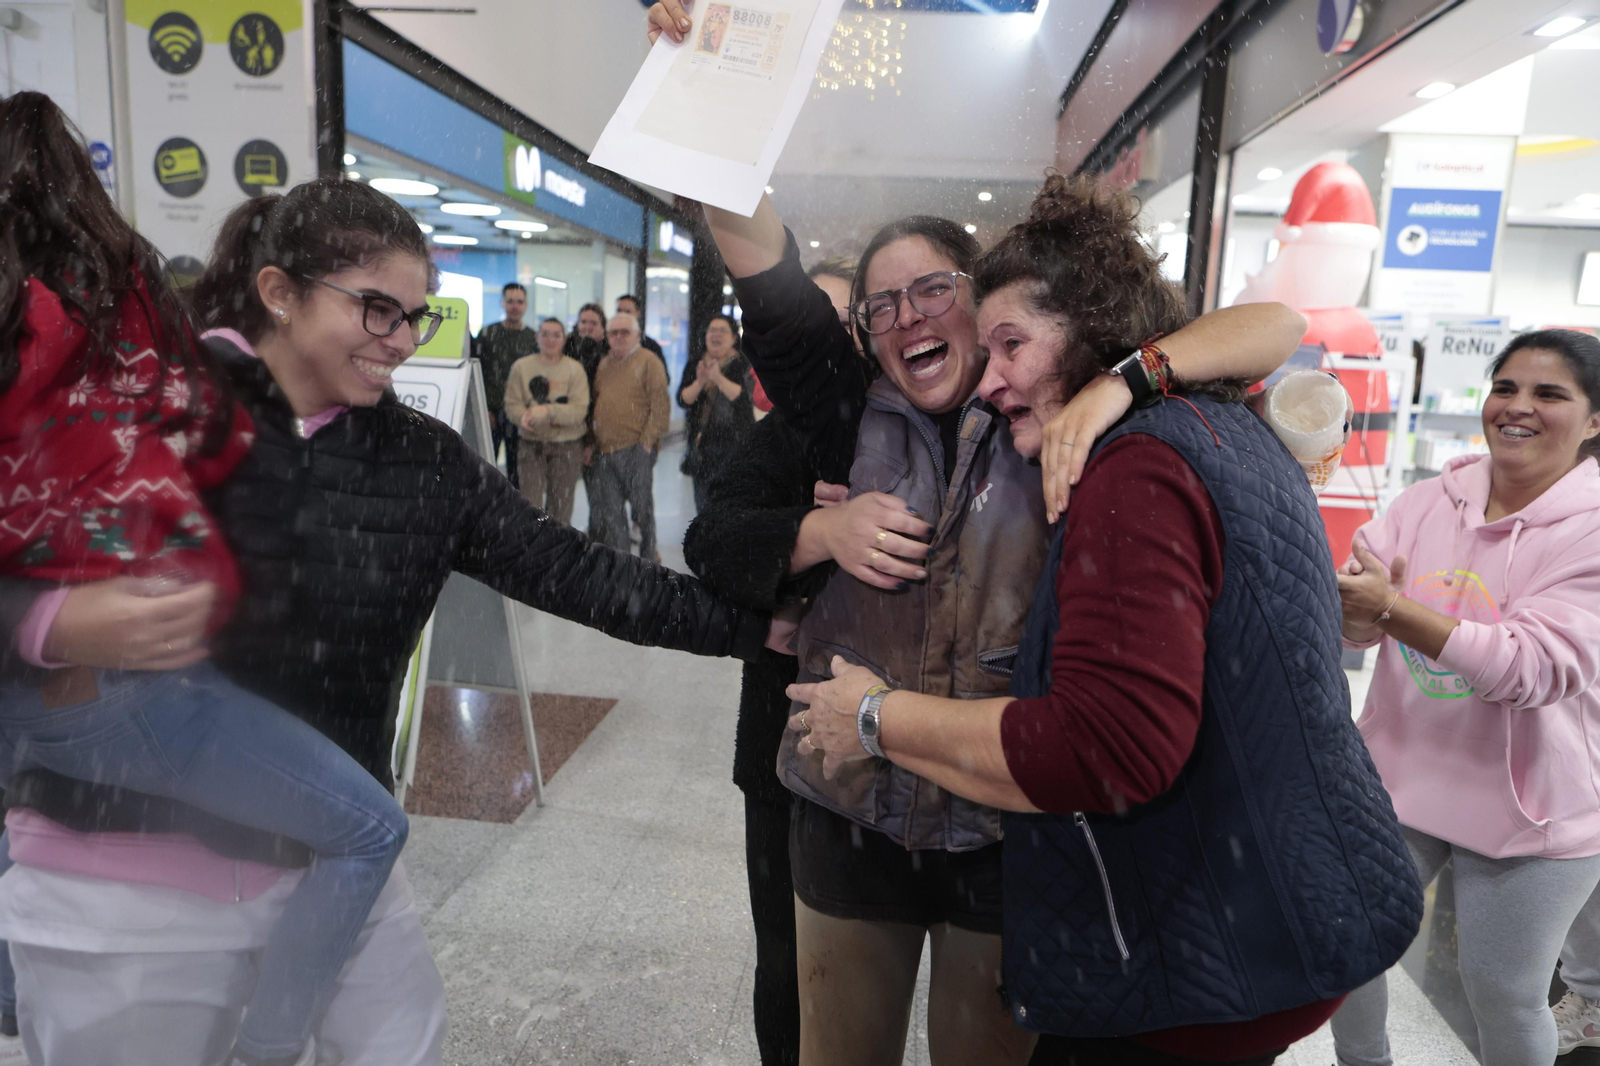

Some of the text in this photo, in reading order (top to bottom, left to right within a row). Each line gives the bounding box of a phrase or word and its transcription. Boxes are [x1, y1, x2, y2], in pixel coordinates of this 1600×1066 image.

[733, 10, 772, 26] 88008
[1408, 201, 1480, 217] AUDÍFONOS
[1442, 336, 1496, 355] ReNu
[1407, 645, 1448, 691] RIGINAL
